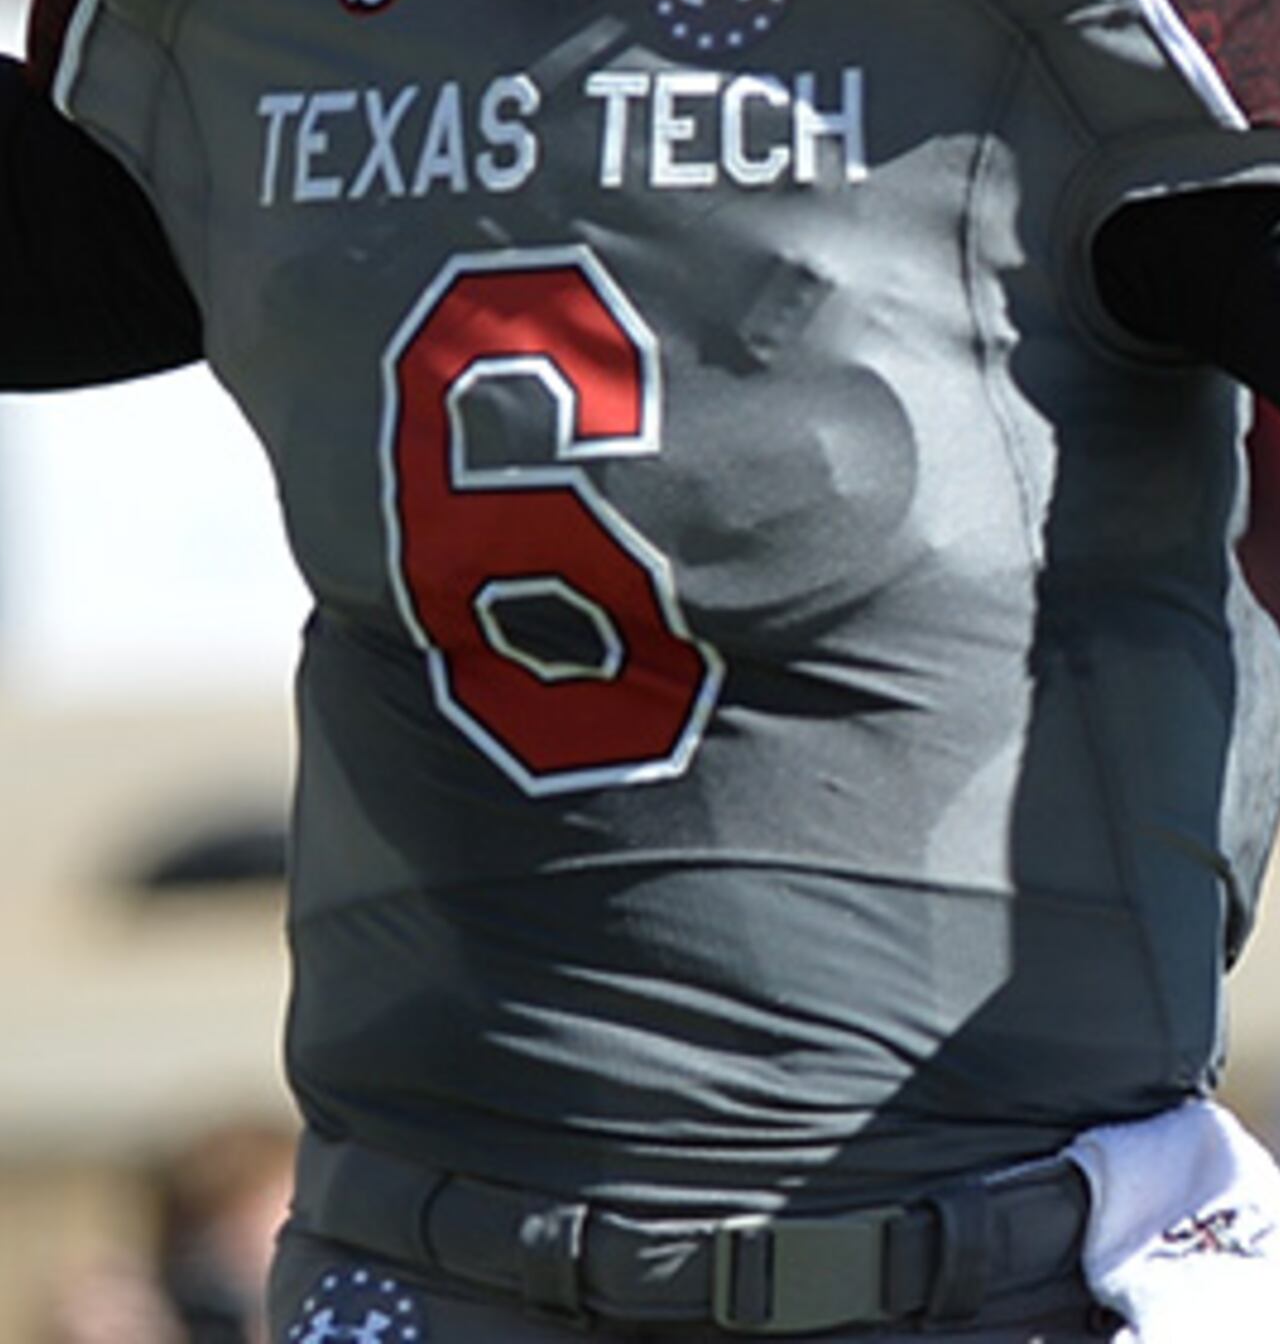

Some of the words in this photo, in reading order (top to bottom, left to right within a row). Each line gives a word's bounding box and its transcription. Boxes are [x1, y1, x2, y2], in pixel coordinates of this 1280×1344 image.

[257, 73, 540, 207] TEXAS
[586, 67, 868, 188] TECH
[380, 243, 726, 798] 6
